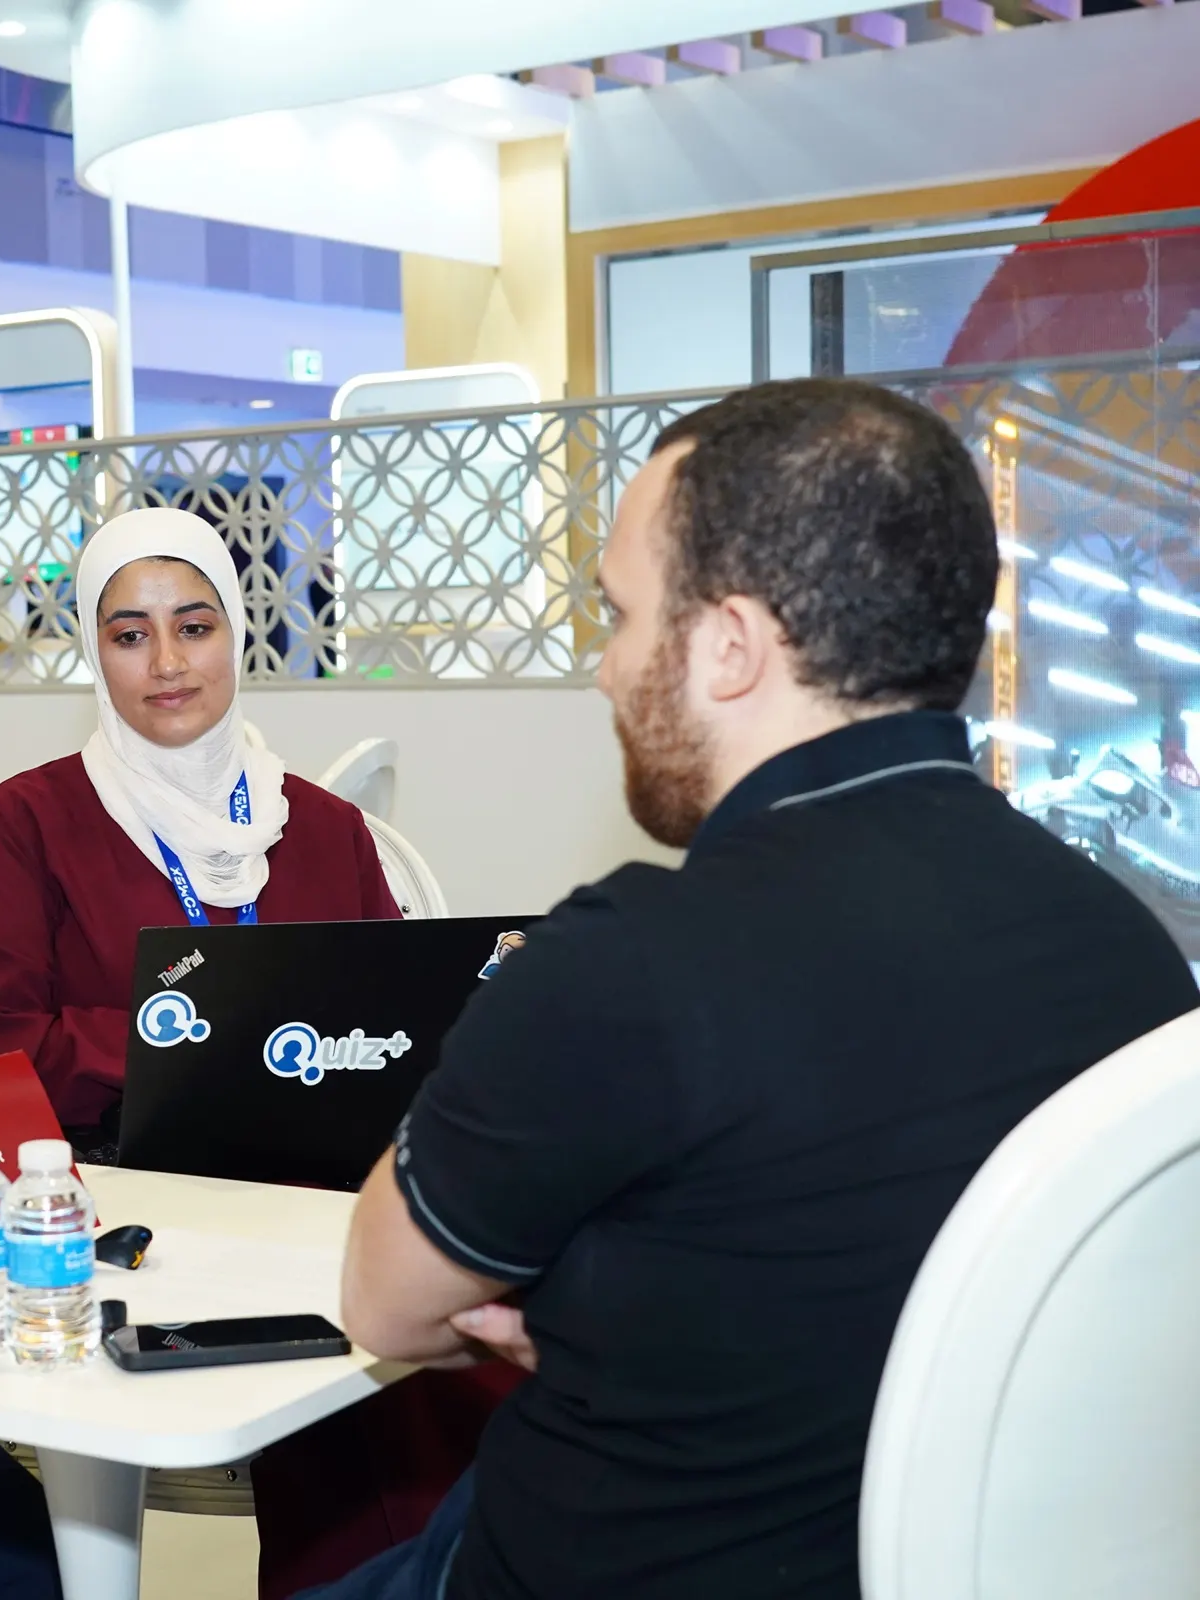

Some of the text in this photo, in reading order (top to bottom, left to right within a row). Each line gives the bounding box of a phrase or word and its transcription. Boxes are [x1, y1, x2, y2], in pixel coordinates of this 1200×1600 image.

[234, 785, 249, 826] OMEX
[170, 866, 200, 918] COMEX
[157, 948, 205, 988] ThinkPad
